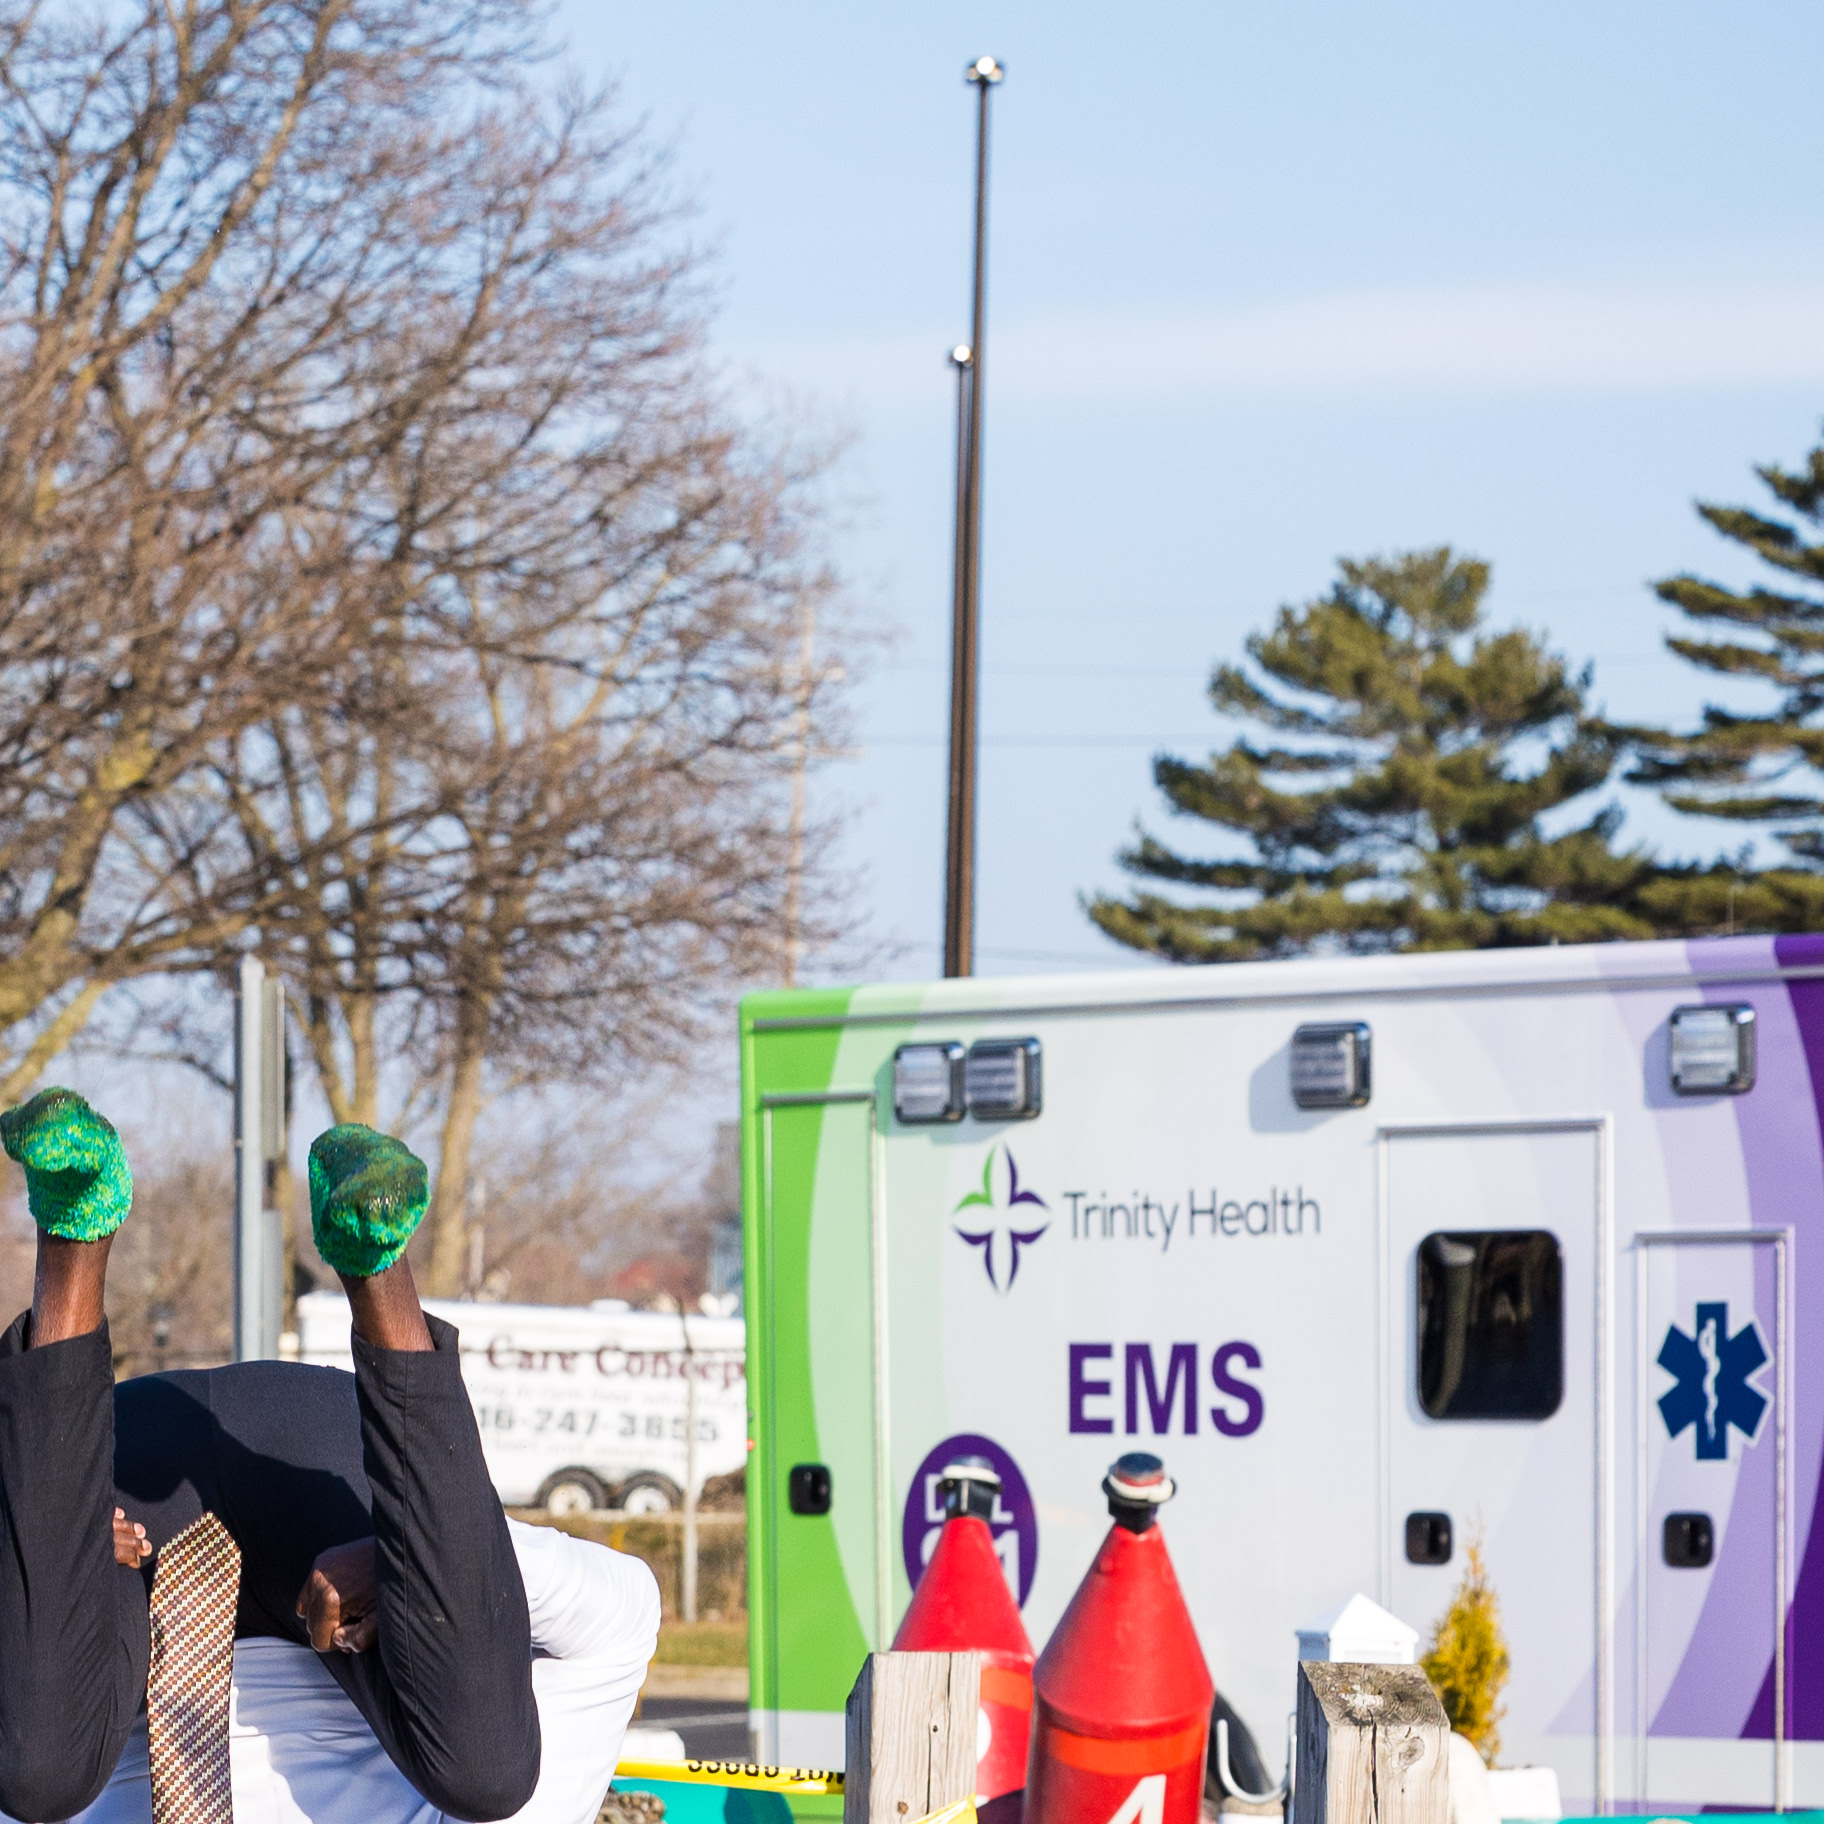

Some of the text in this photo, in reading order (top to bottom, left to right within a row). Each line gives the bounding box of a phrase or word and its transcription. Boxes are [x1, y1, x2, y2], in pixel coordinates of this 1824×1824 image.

[1062, 1185, 1322, 1255] Trinity Health
[486, 1334, 578, 1373] Care
[1068, 1340, 1265, 1438] EMS
